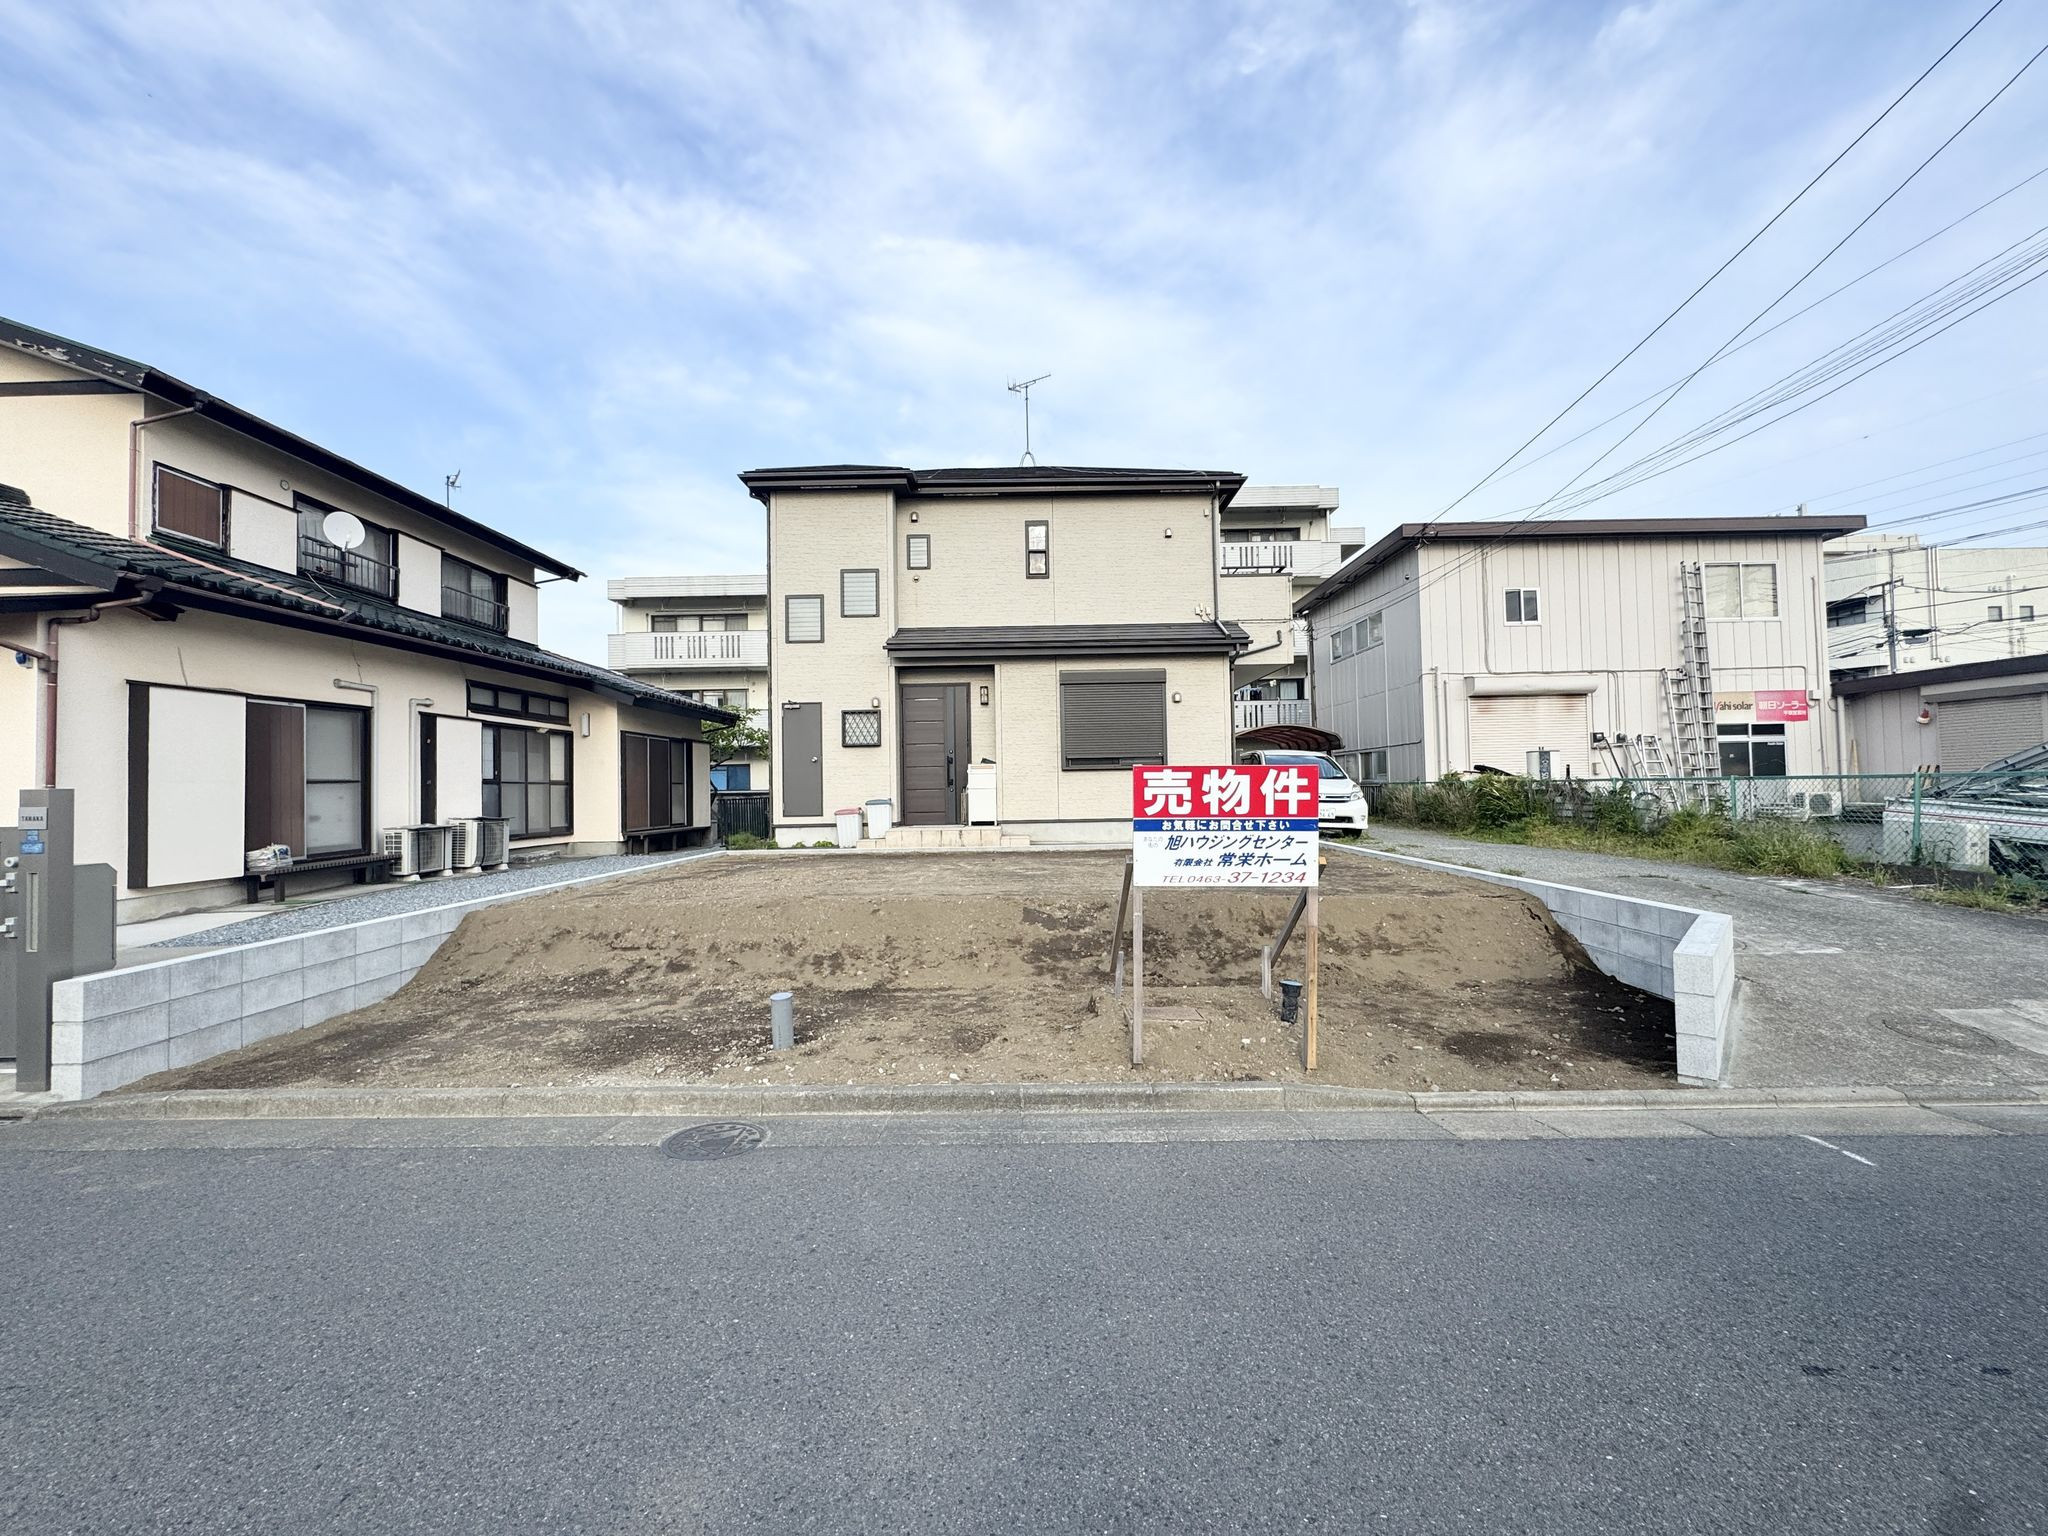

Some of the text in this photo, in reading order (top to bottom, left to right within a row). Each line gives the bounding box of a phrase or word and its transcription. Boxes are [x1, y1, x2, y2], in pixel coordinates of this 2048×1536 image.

[1732, 701, 1752, 710] solar
[1142, 768, 1311, 815] 売物件
[1161, 820, 1290, 831] お気軽にお問合せ下さい
[1164, 834, 1308, 851] 旭ハウジングセンター
[1173, 852, 1307, 868] 有限会社 常栄ホーム
